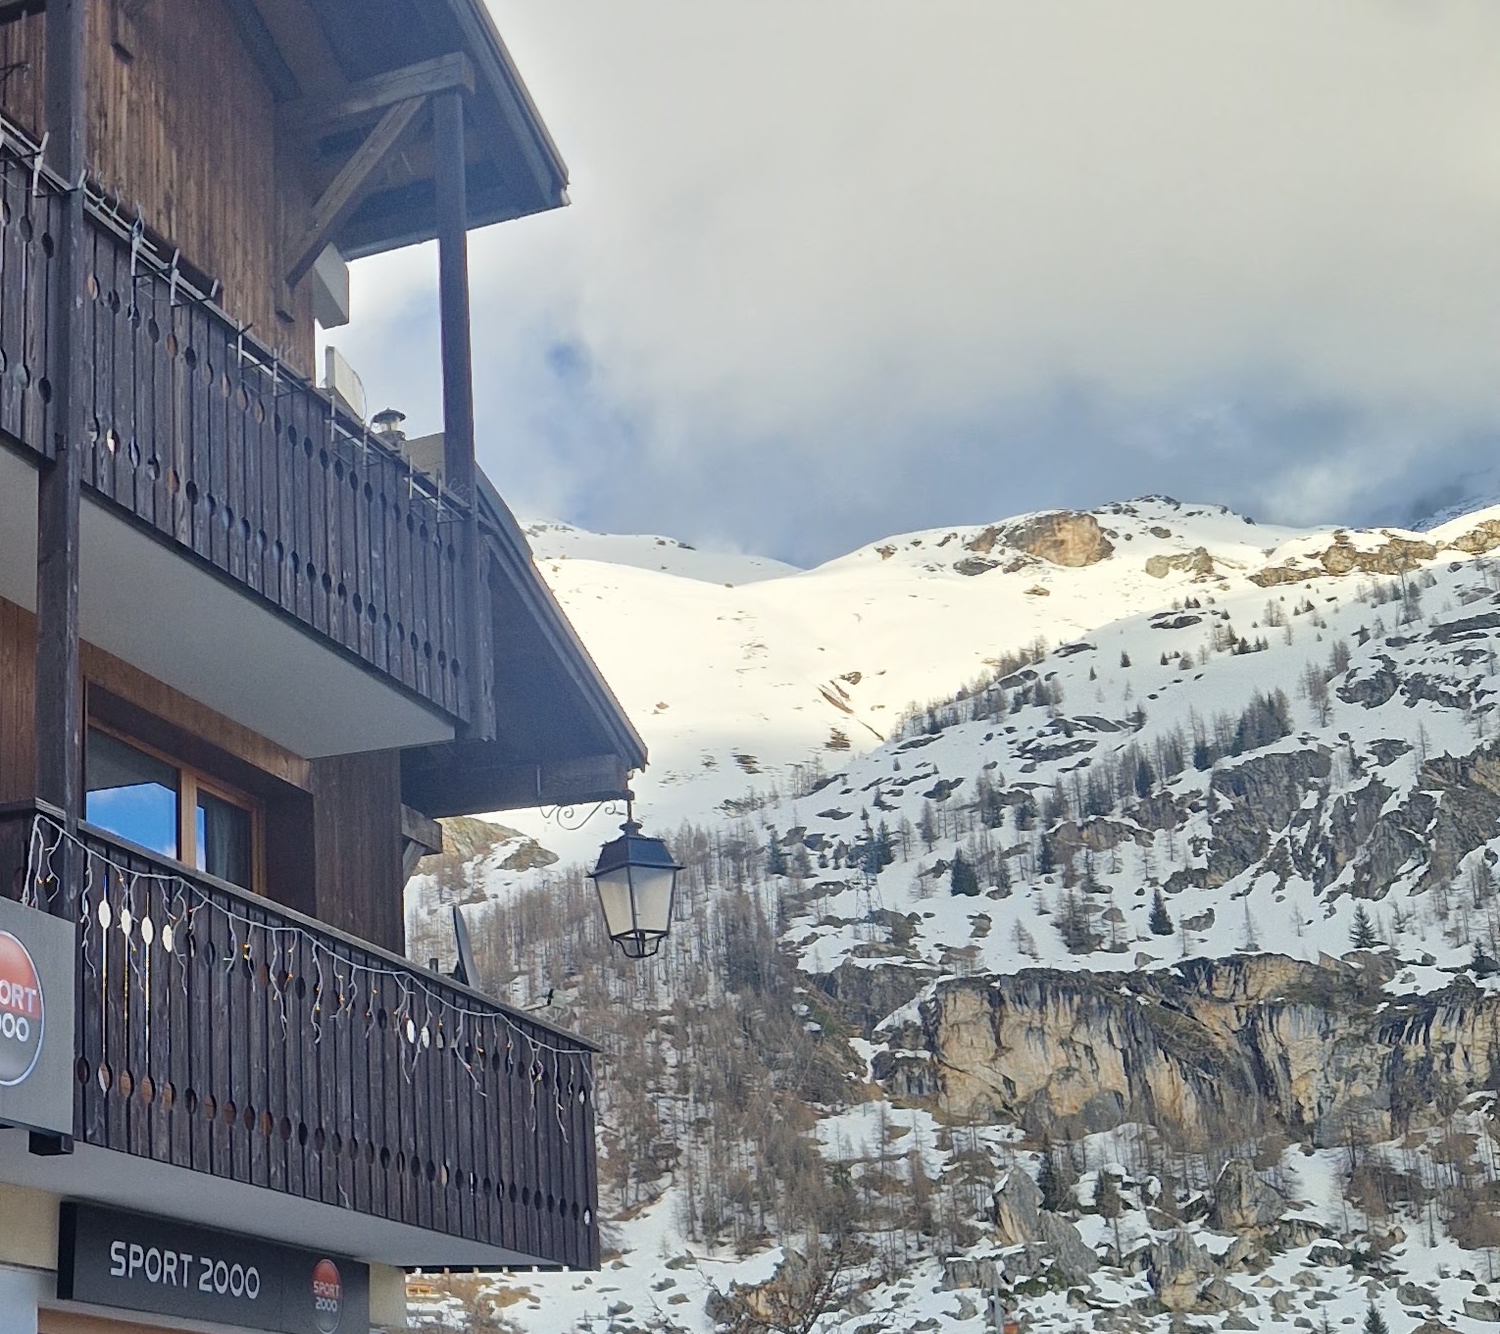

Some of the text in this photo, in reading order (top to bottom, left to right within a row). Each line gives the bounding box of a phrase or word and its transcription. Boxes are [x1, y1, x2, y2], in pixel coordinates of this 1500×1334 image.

[110, 1240, 260, 1299] SPORT 2000
[313, 1280, 340, 1299] SPORT
[315, 1296, 338, 1313] 2000
